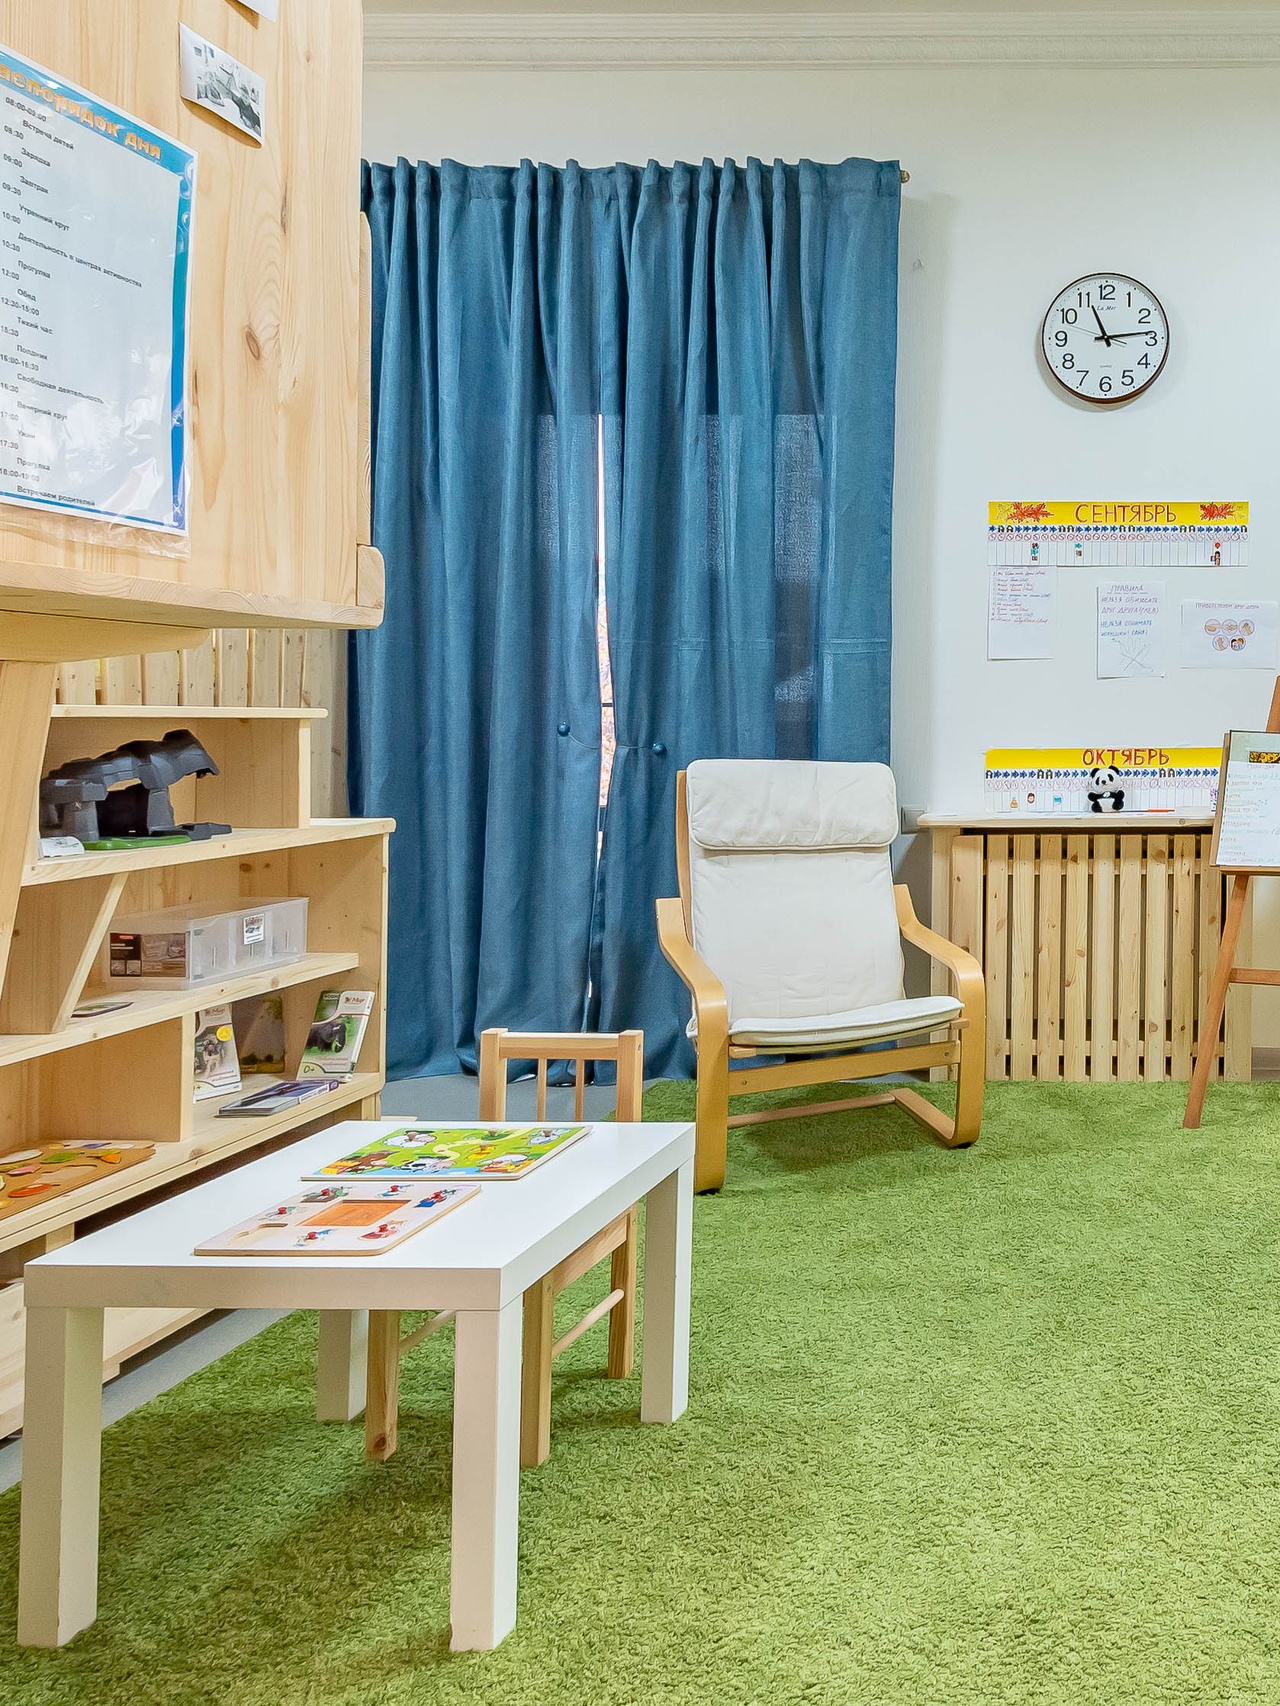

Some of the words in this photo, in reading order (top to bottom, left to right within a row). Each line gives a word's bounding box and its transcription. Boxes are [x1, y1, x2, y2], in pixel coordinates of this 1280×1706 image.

[0, 63, 119, 138] аспорядок
[124, 131, 162, 160] дня
[3, 153, 23, 168] 09:00
[2, 182, 22, 196] 09:30
[2, 211, 21, 224] 10:00
[54, 220, 70, 231] круг
[2, 239, 20, 252] 10:30
[18, 232, 68, 258] Деятельность
[1, 268, 19, 280] 12:00
[18, 259, 51, 279] Прогулка
[17, 288, 36, 302] Обед
[1077, 291, 1091, 308] 11
[1098, 284, 1116, 300] 12
[1126, 291, 1132, 308] 1
[1, 297, 40, 316] 12:30-15:00
[1060, 307, 1078, 325] 10
[1138, 308, 1151, 324] 2
[40, 325, 53, 335] час
[1144, 330, 1158, 347] 3
[1054, 330, 1068, 348] 9
[1062, 353, 1075, 370] 8
[1137, 352, 1151, 369] 4
[1076, 370, 1089, 386] 7
[1099, 375, 1112, 392] 6
[1121, 369, 1134, 386] 5
[17, 372, 57, 390] Свободная
[57, 386, 104, 404] деятельность
[0, 440, 19, 449] 17:30
[1075, 504, 1177, 523] СЕНТЯБРЬ
[1082, 748, 1170, 766] ОКТЯБРЬ
